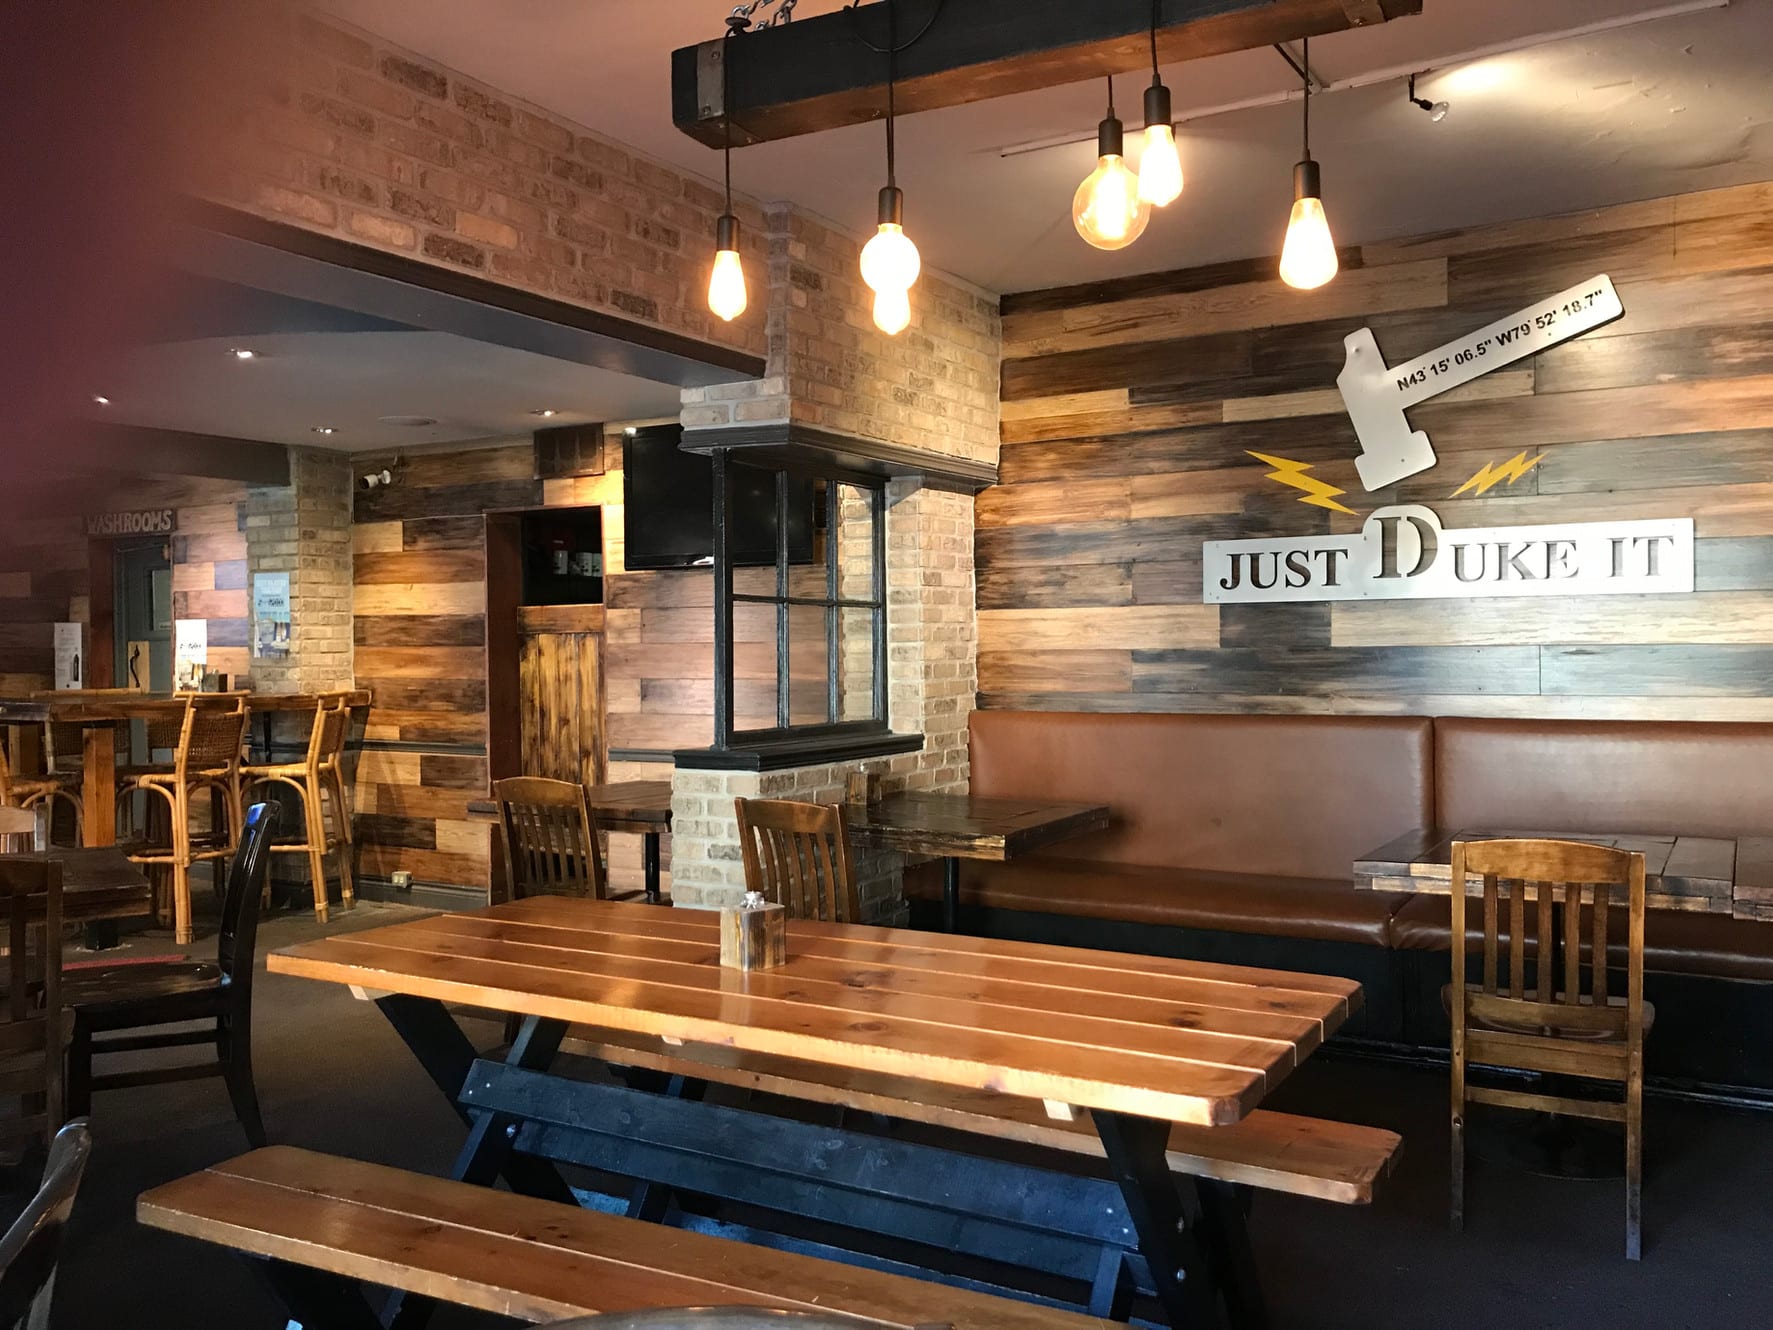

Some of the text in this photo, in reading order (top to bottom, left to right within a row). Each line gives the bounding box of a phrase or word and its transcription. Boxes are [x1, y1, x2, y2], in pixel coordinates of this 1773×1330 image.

[1430, 358, 1450, 376] 15'
[1454, 339, 1492, 366] 06.5"
[1535, 310, 1558, 330] 52'
[87, 509, 173, 534] WASHROOMS
[1219, 515, 1675, 591] JUST DUKE IT
